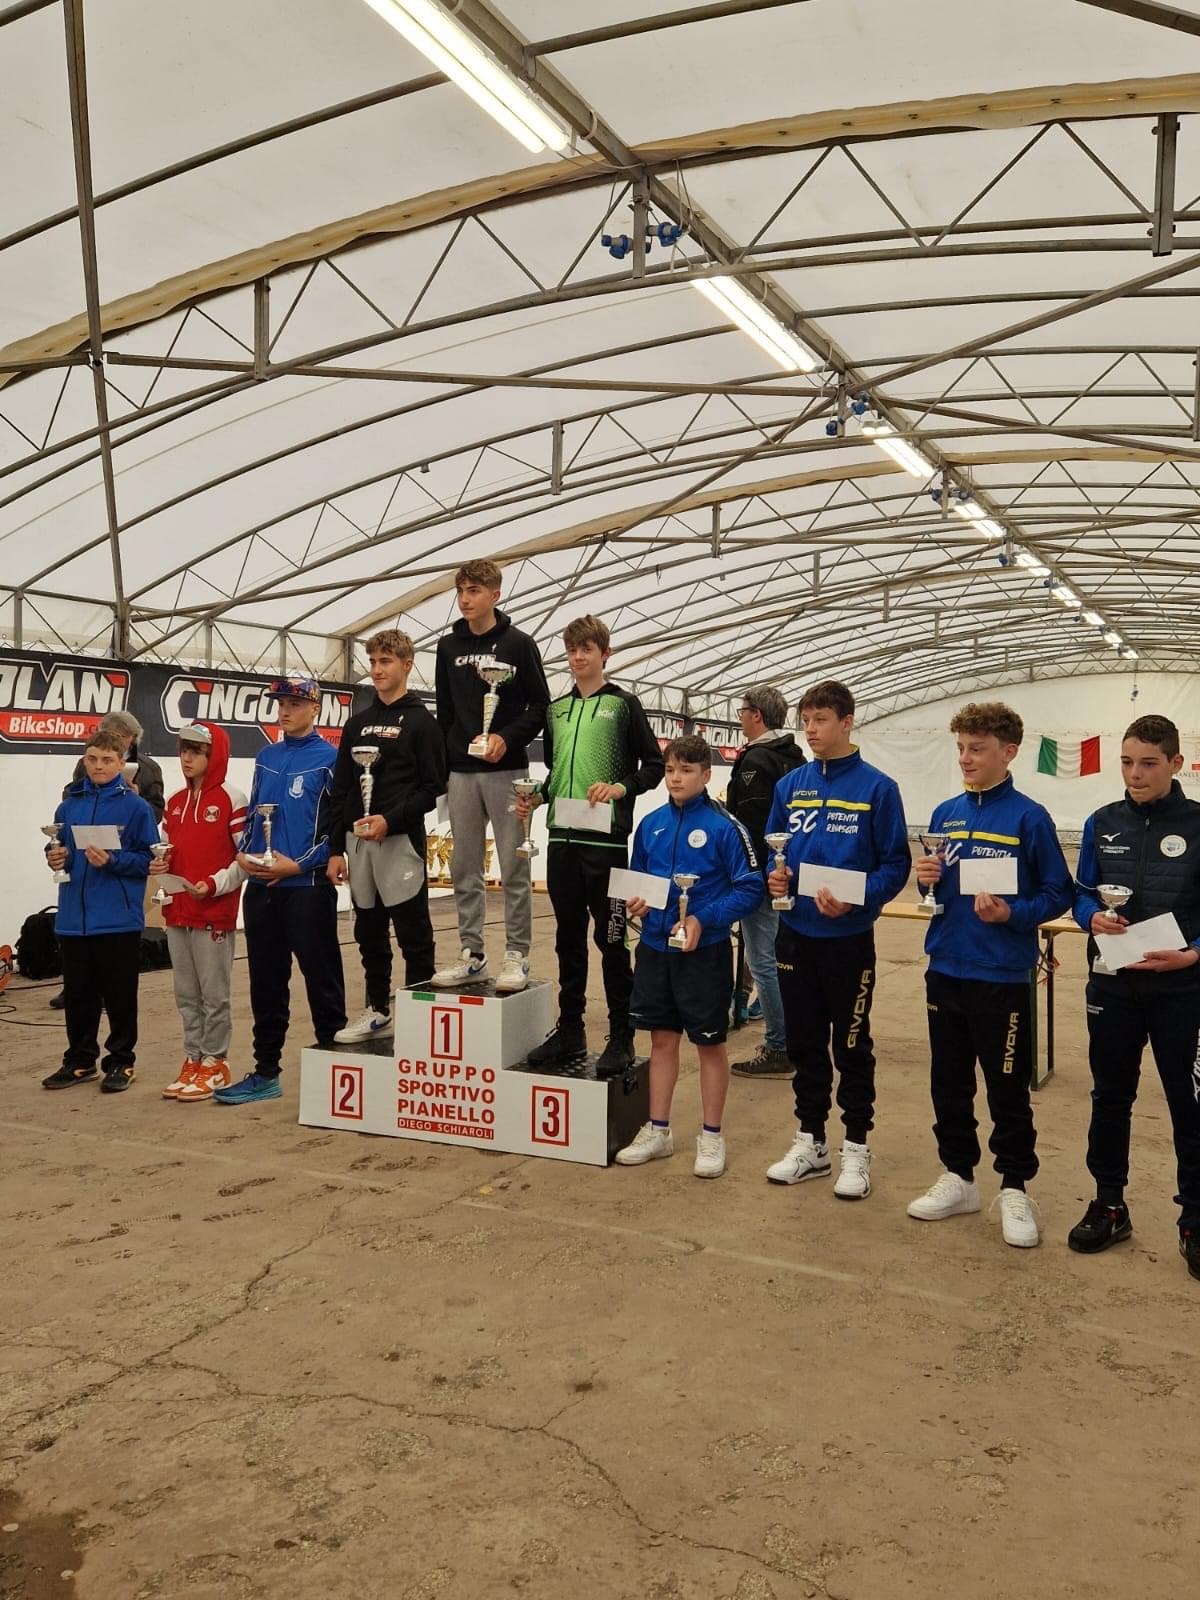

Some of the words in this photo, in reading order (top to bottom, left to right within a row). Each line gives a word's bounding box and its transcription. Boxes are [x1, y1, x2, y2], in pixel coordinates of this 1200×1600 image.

[789, 809, 819, 833] SC
[847, 969, 872, 1048] GIVOVA
[440, 1013, 451, 1053] 1
[1003, 1012, 1019, 1074] GIVOVA
[398, 1058, 496, 1084] GRUPPO
[339, 1073, 355, 1112] 2
[398, 1078, 496, 1105] SPORTIVO
[398, 1098, 495, 1125] PIANELLO
[542, 1095, 560, 1138] 3
[399, 1118, 432, 1130] DIEGO
[437, 1122, 494, 1139] SCHIAROLI
